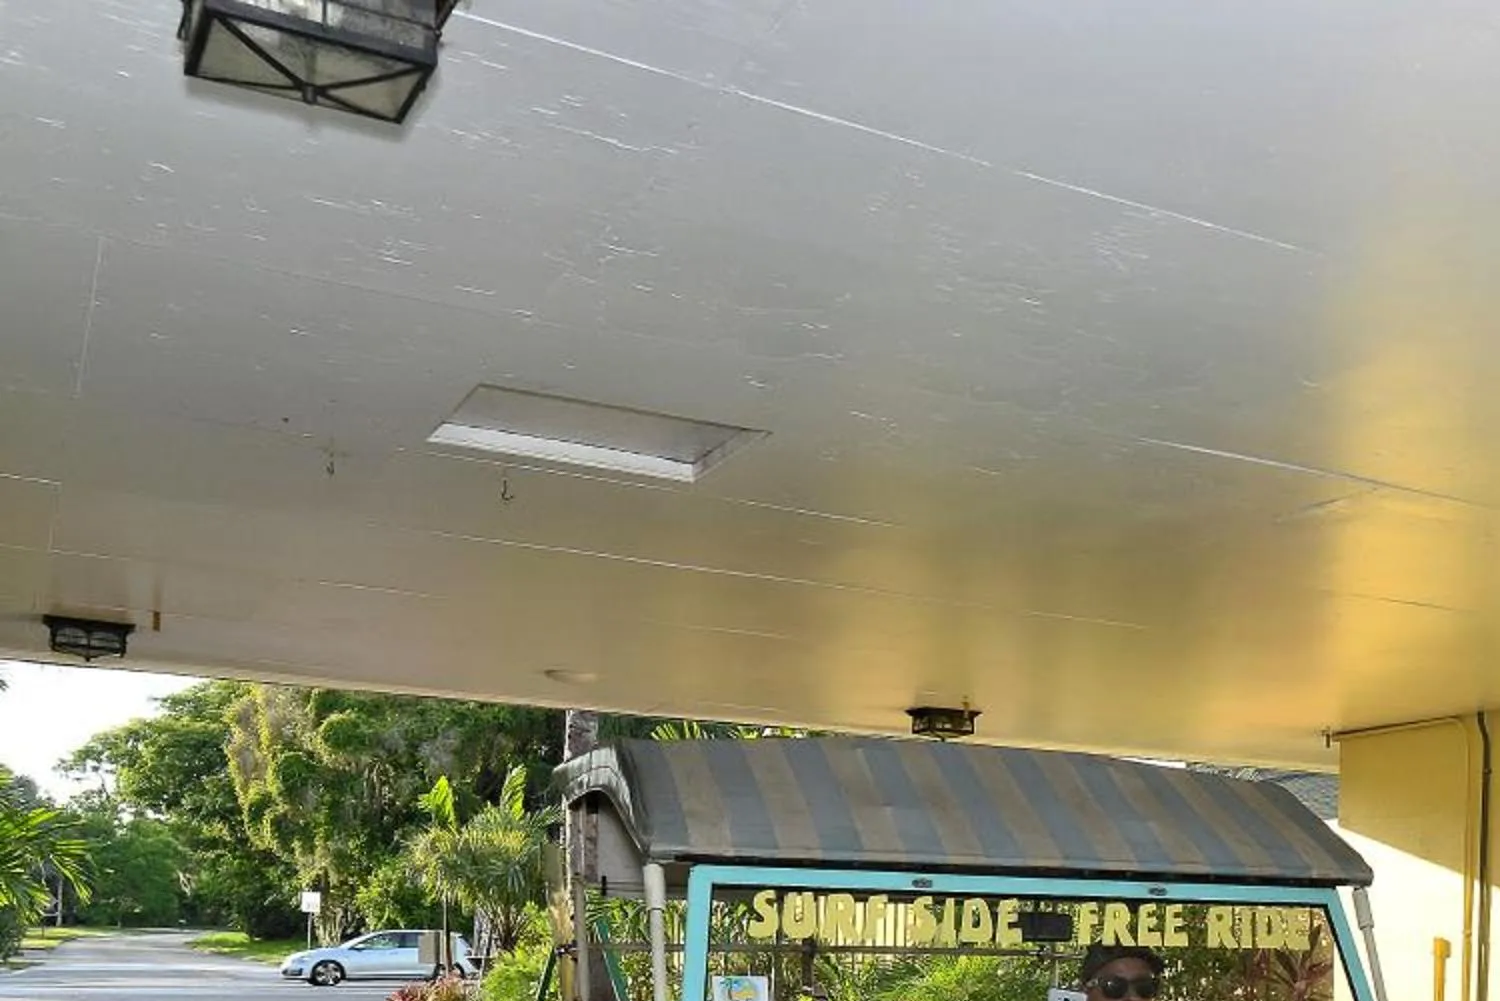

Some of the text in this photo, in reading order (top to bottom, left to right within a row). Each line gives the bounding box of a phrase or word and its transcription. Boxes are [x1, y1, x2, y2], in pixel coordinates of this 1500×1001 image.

[748, 889, 1311, 949] SURF SIDE FREE RIDE
